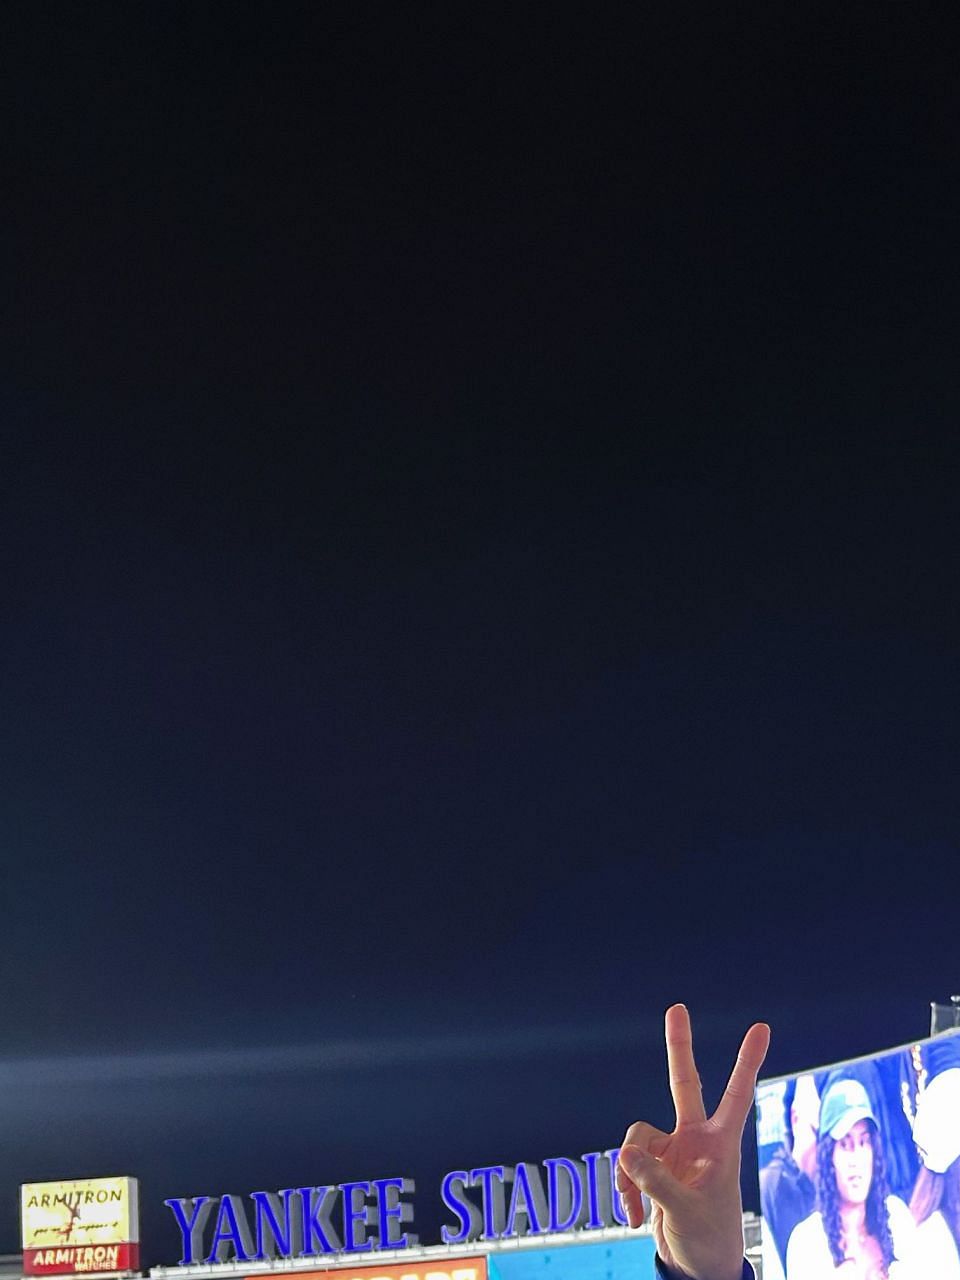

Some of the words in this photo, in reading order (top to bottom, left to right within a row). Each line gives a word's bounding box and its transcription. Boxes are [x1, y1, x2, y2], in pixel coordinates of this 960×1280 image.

[27, 1189, 122, 1209] ARMITRON
[164, 1177, 412, 1266] YANKEE
[33, 1246, 119, 1267] ARMITRON
